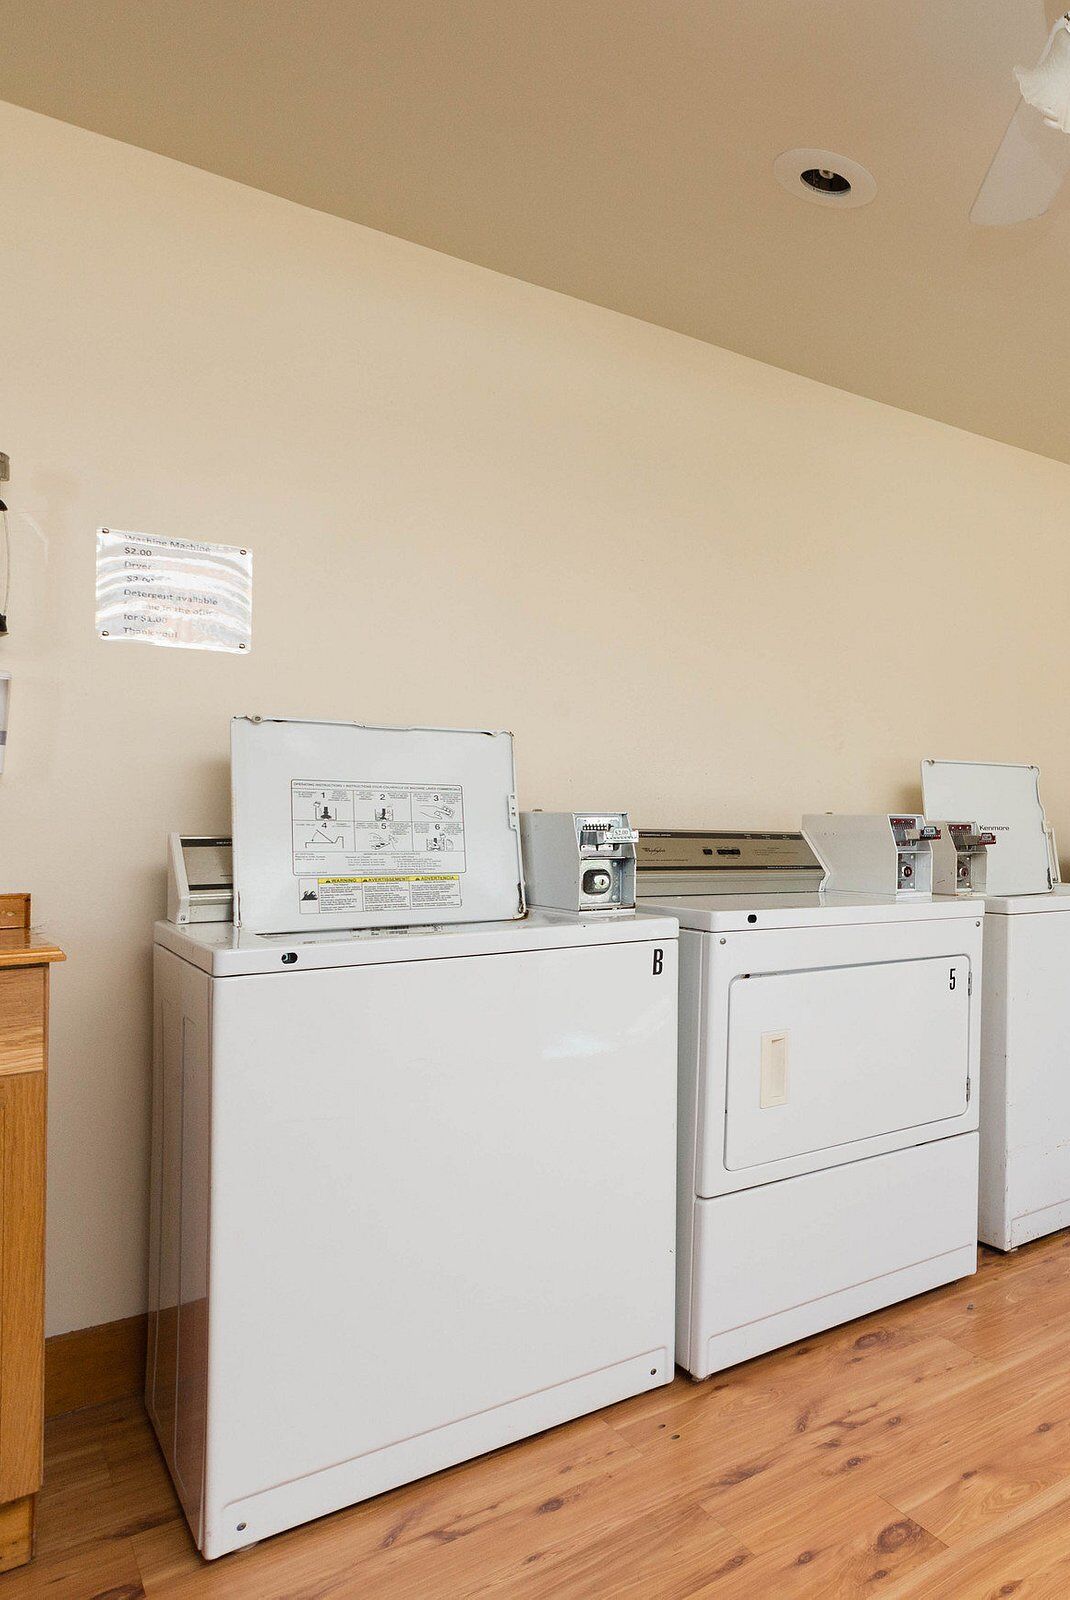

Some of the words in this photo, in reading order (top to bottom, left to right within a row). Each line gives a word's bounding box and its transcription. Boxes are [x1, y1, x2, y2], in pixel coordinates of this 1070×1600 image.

[124, 546, 152, 556] $2.00
[170, 541, 211, 552] Machine
[124, 561, 151, 570] Dryer
[123, 588, 173, 600] Detergent
[176, 594, 218, 606] available
[379, 793, 386, 801] 2
[979, 823, 1010, 831] Kenmore
[652, 948, 664, 976] B
[949, 968, 956, 990] 5
